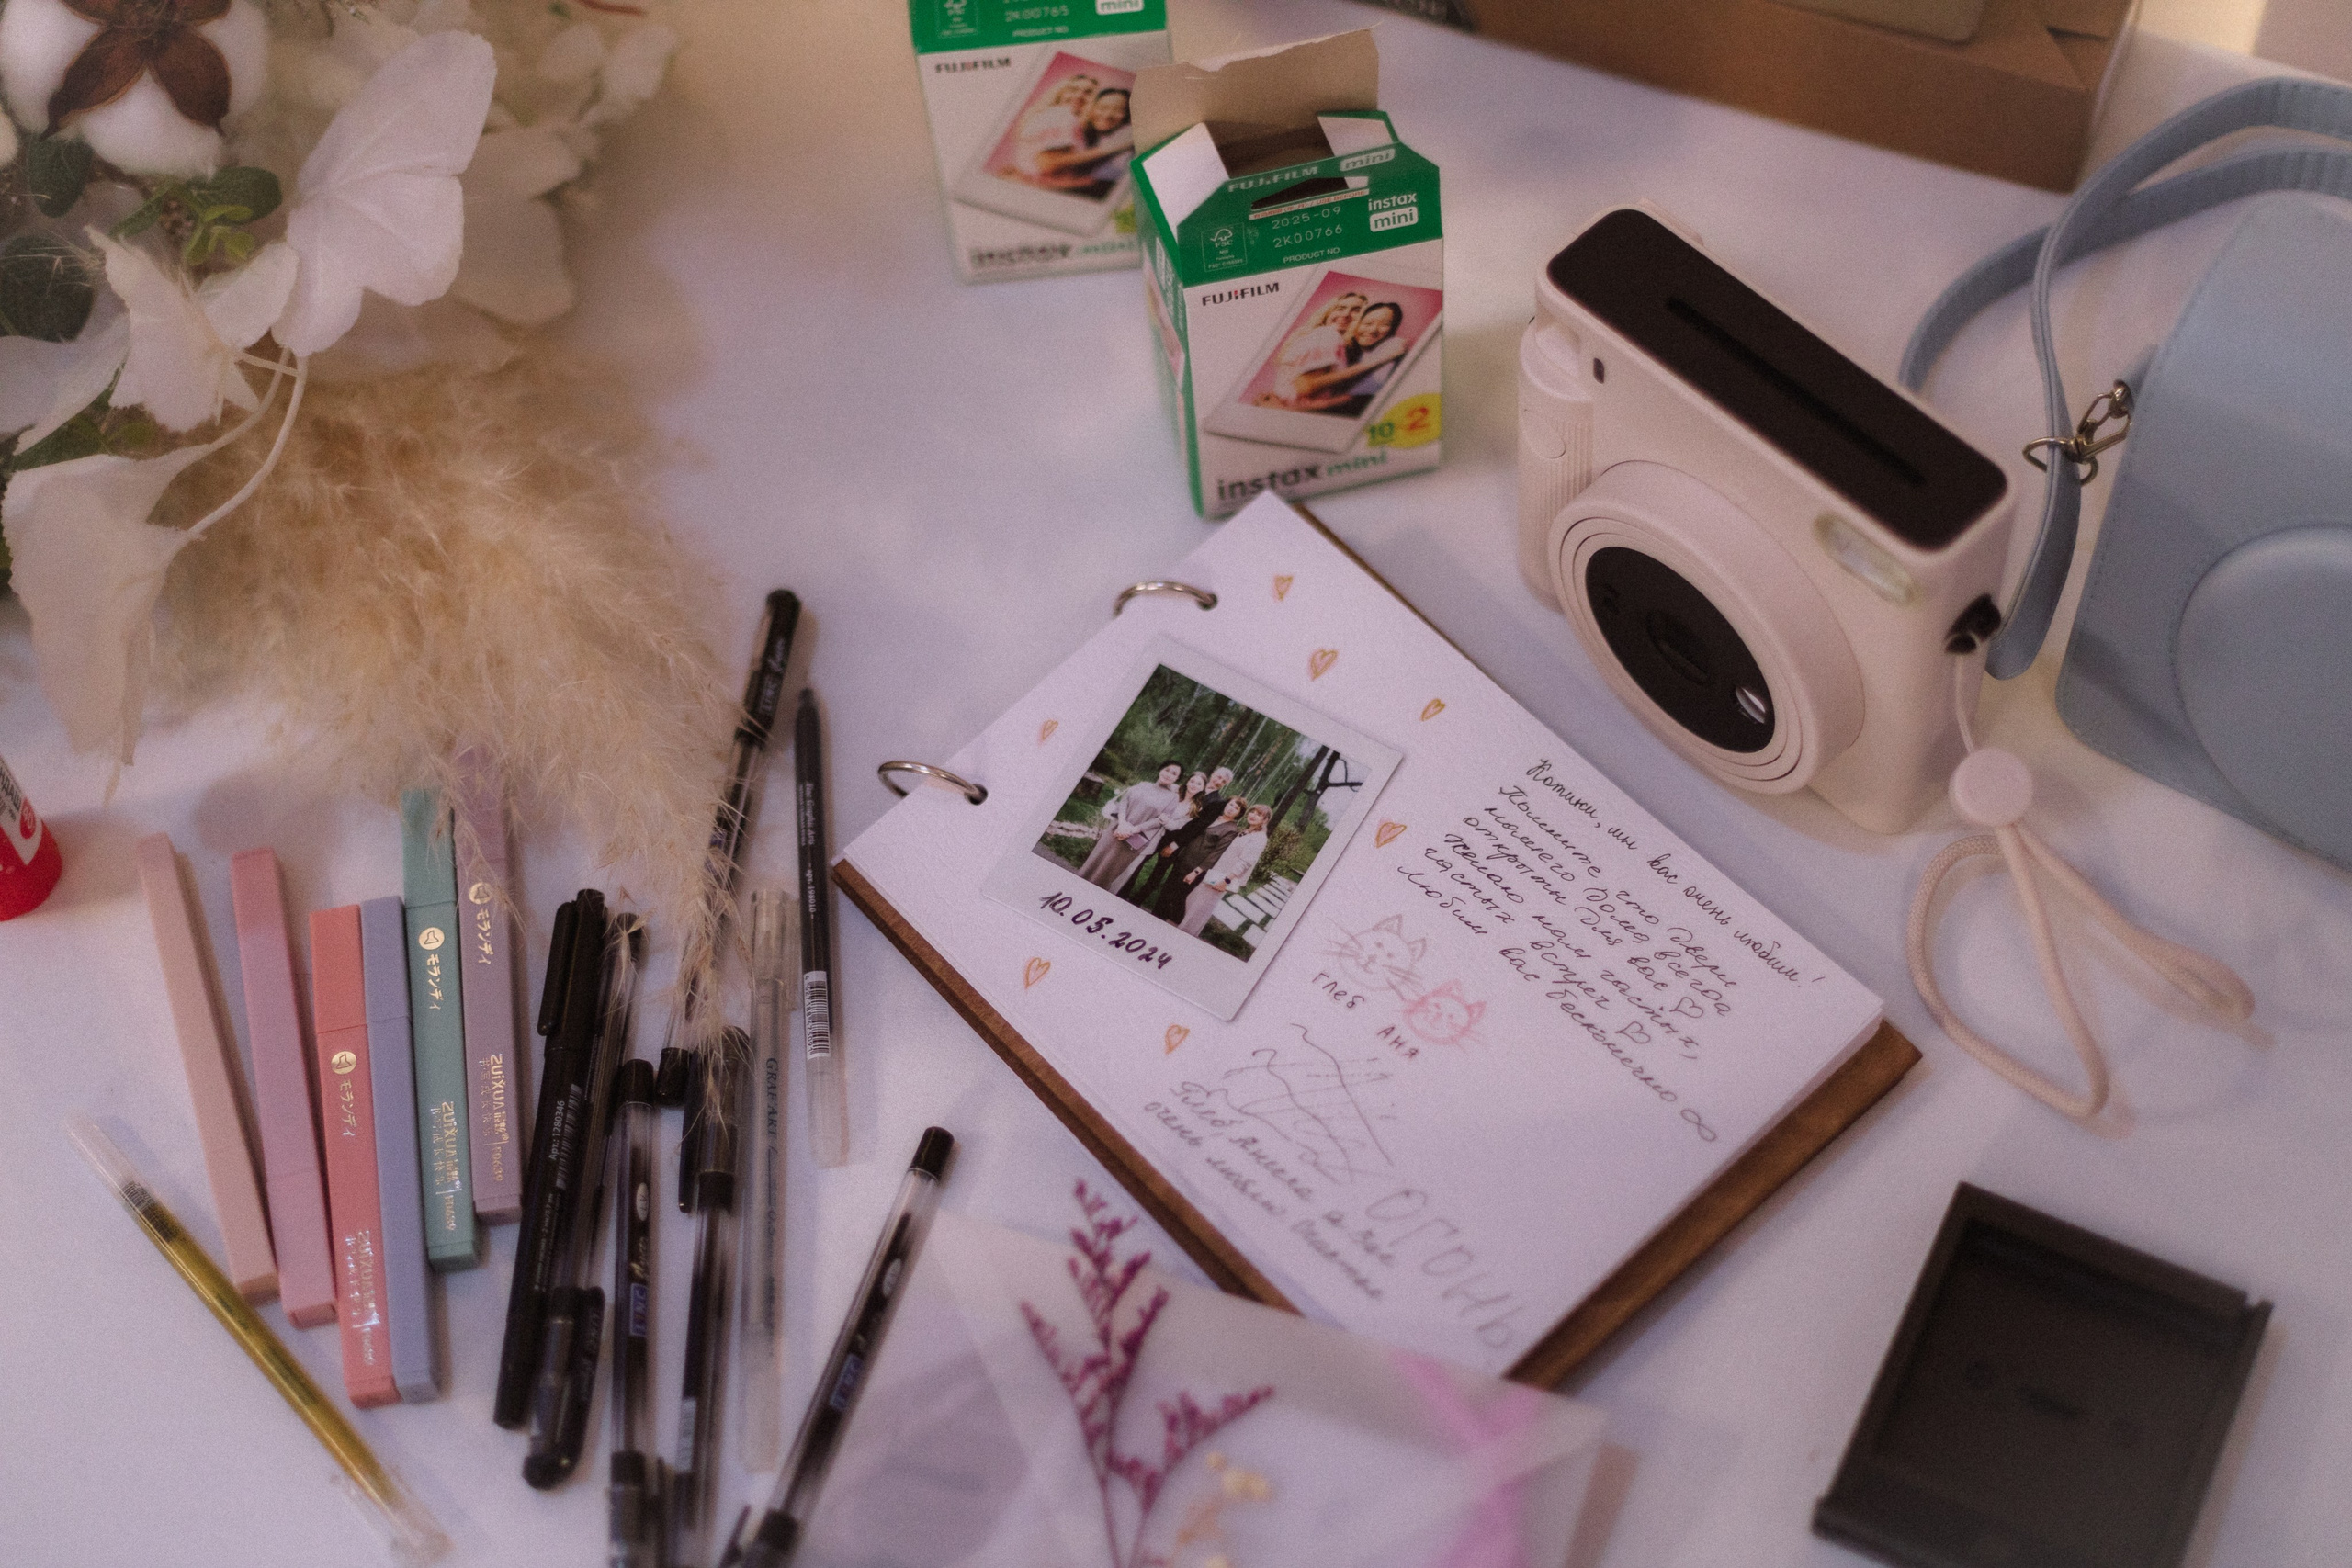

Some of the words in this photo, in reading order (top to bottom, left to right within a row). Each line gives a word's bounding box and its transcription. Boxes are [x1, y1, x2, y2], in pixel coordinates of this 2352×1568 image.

[1228, 166, 1317, 192] FUJIFILM
[1272, 206, 1341, 230] 2025-09
[1368, 193, 1417, 211] instax
[1374, 209, 1415, 229] mini
[1272, 224, 1342, 248] 2K00766
[1283, 249, 1325, 264] PRODUCT
[1202, 282, 1280, 307] FUJIFILM
[1216, 464, 1321, 500] instax
[1526, 758, 1601, 829] Котики,
[1607, 825, 1638, 851] мы
[1647, 853, 1679, 886] вас
[1684, 885, 1732, 927] очень
[1462, 815, 1568, 907] открыты
[1574, 905, 1623, 947] для
[1626, 955, 1669, 992] вас
[1484, 806, 1577, 884] нашего
[1582, 886, 1651, 946] дома
[1654, 949, 1733, 1019] всегда
[1424, 847, 1516, 925] частых
[1530, 940, 1611, 1010] встреч
[1614, 888, 1661, 926] что
[1666, 926, 1738, 990] двери
[426, 953, 445, 1010] モランディ
[1498, 945, 1541, 983] вас
[1545, 986, 1679, 1103] бесконечно
[338, 1077, 358, 1137] モランディ
[551, 1100, 566, 1138] 1280346
